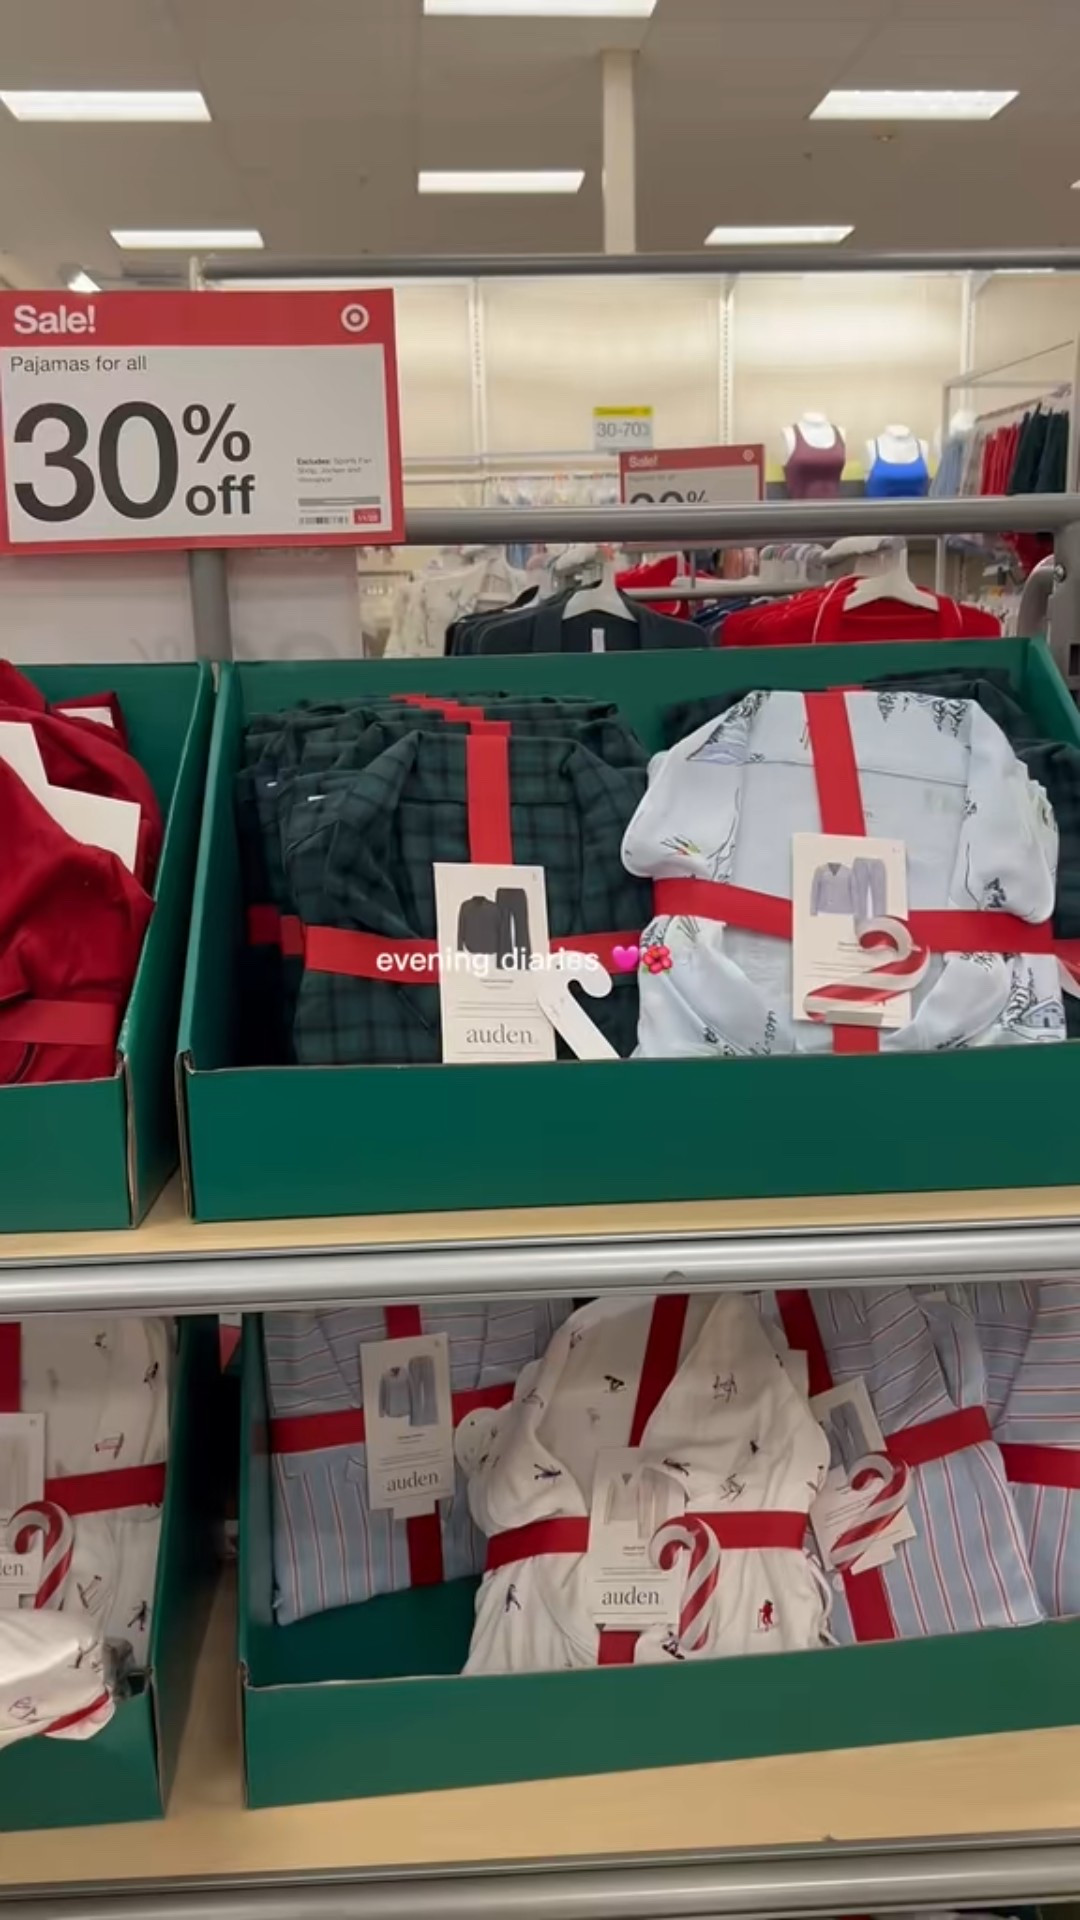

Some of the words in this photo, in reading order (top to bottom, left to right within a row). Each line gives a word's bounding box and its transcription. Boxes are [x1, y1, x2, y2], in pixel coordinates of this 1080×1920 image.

[13, 304, 96, 335] Sale!
[10, 355, 91, 375] Pajamas
[95, 356, 121, 371] for
[126, 355, 147, 371] all
[13, 400, 252, 523] 30%
[185, 474, 256, 517] off
[465, 1022, 532, 1044] auden
[386, 1471, 439, 1492] auden
[601, 1585, 660, 1606] auden
